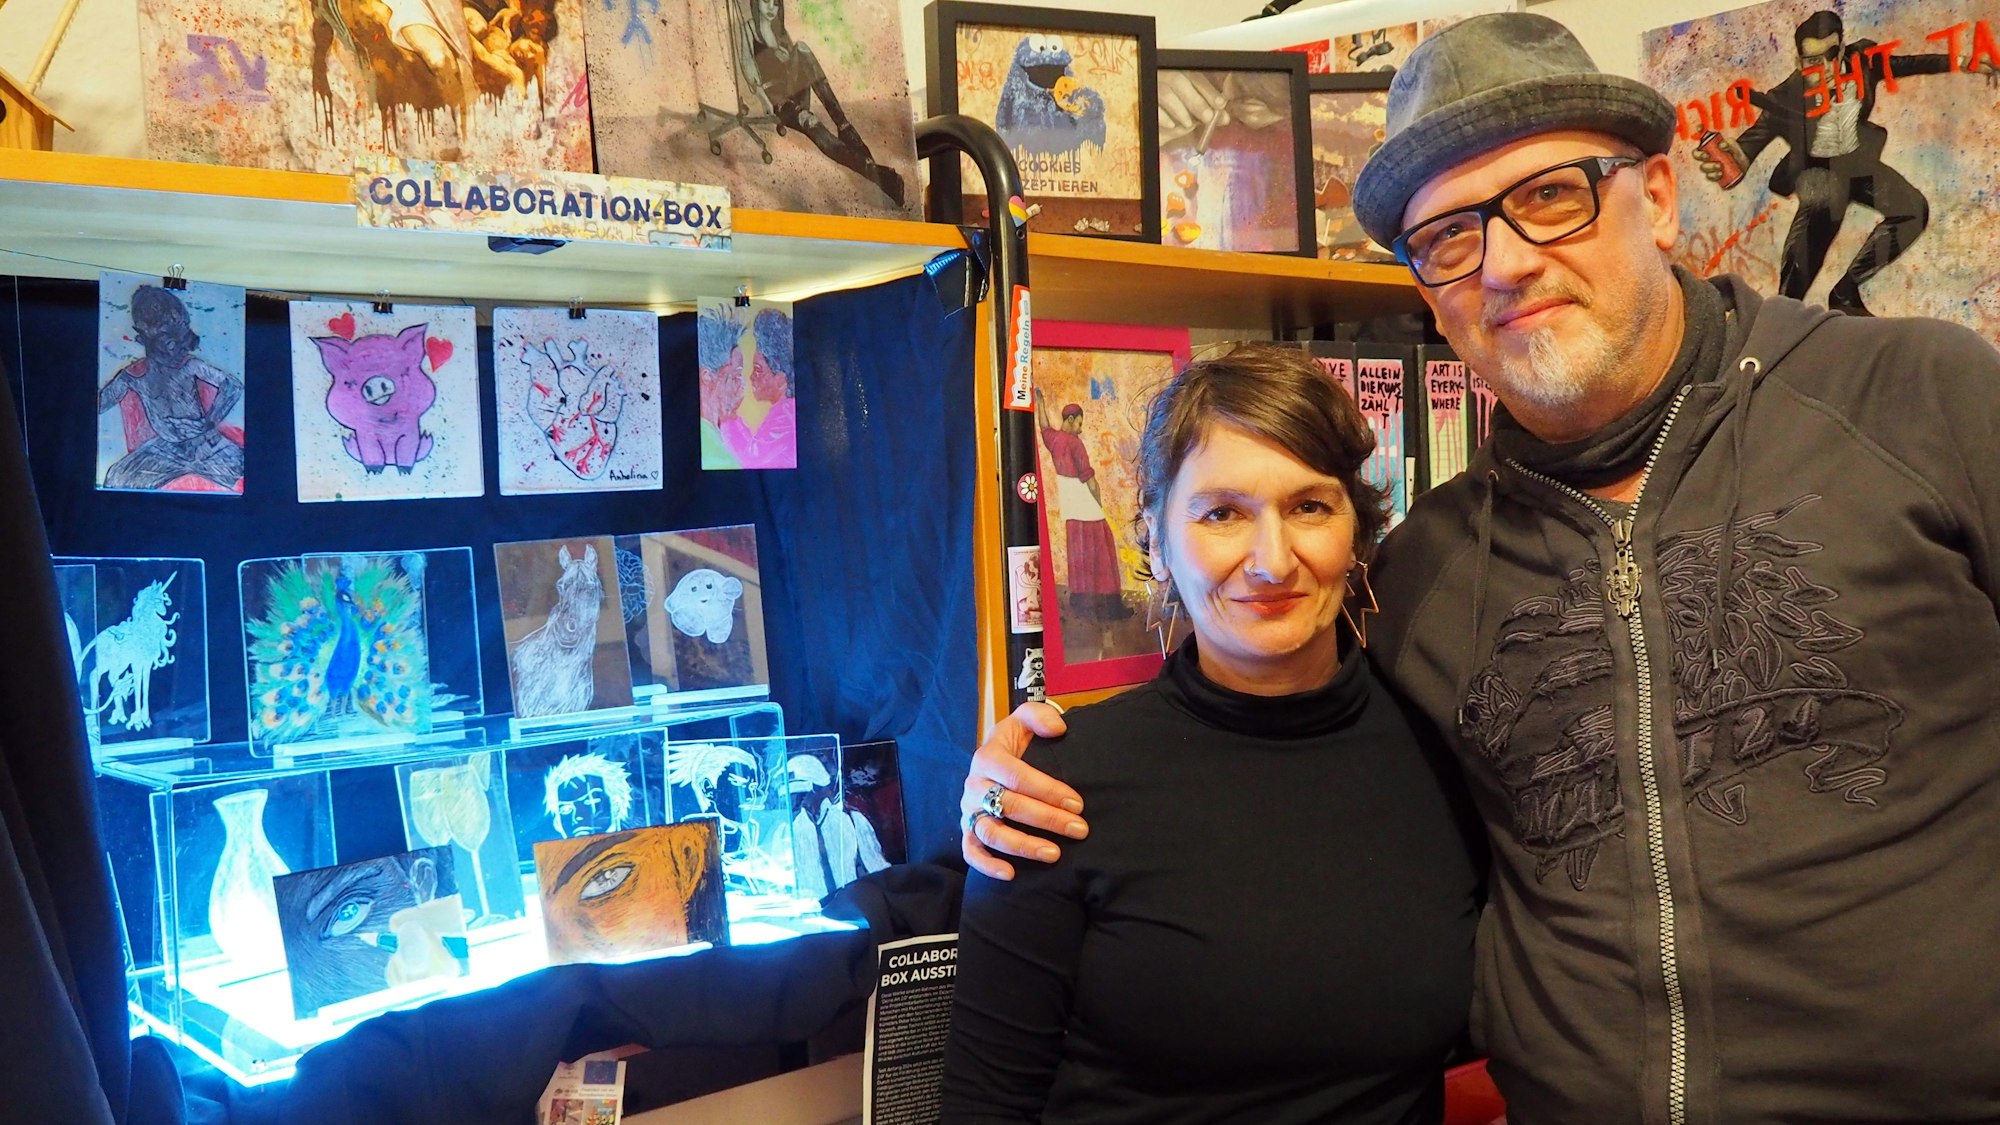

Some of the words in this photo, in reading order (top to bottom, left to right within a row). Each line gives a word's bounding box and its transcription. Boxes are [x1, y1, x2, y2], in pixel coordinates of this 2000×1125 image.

[1018, 160, 1081, 174] COOKIES
[368, 176, 723, 230] COLLABORATION-BOX
[1020, 320, 1031, 364] Regeln
[1360, 367, 1401, 380] ALLEIN
[1431, 363, 1450, 377] ART
[1453, 364, 1463, 377] IS
[1016, 366, 1028, 401] Meine
[1431, 397, 1461, 411] WHERE
[881, 970, 908, 988] BOX
